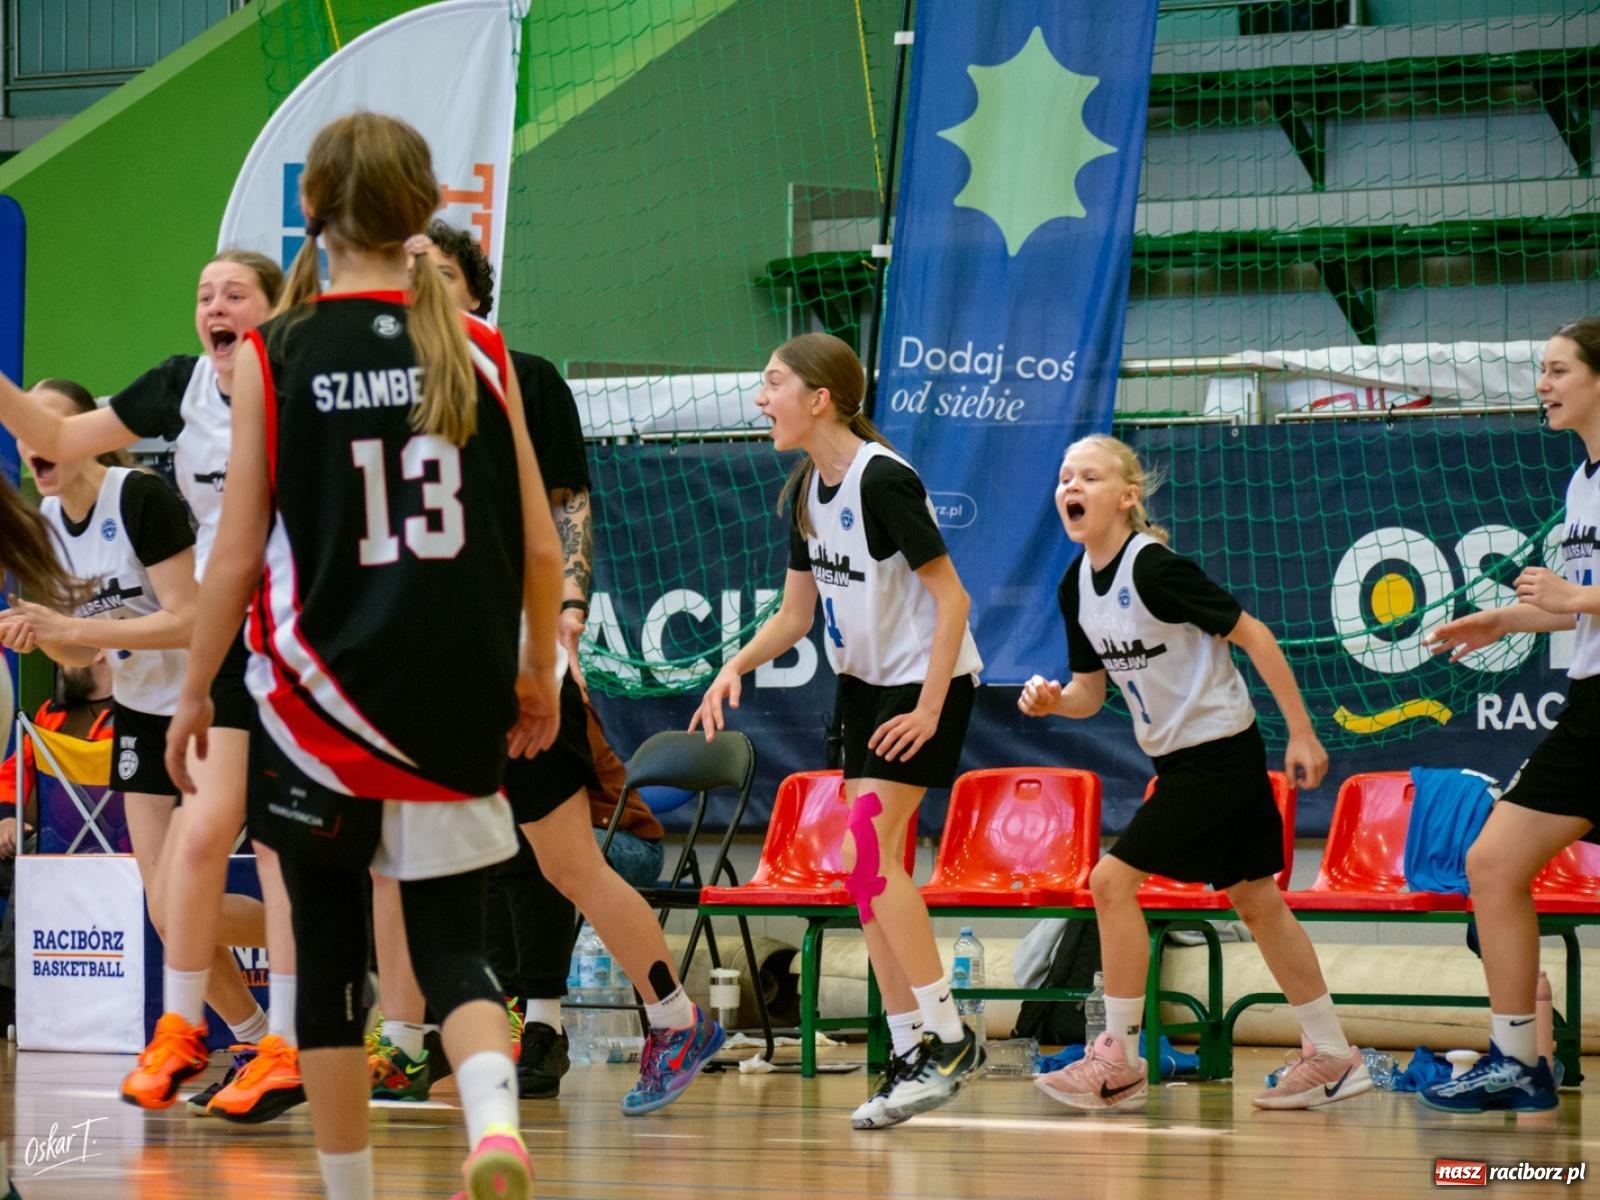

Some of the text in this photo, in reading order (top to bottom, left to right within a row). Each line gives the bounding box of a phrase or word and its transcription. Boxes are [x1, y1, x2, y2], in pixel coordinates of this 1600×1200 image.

[898, 335, 1077, 385] Dodaj coś
[311, 366, 425, 413] SZAMBE
[891, 380, 1026, 423] od siebie
[351, 433, 466, 567] 13
[935, 502, 963, 519] rz.pl
[578, 589, 819, 689] ACIB
[1127, 679, 1152, 724] 1
[1476, 691, 1567, 731] RAC
[33, 925, 125, 951] RACIBÓRZ
[33, 959, 125, 978] BASKETBALL
[241, 969, 270, 986] ALL
